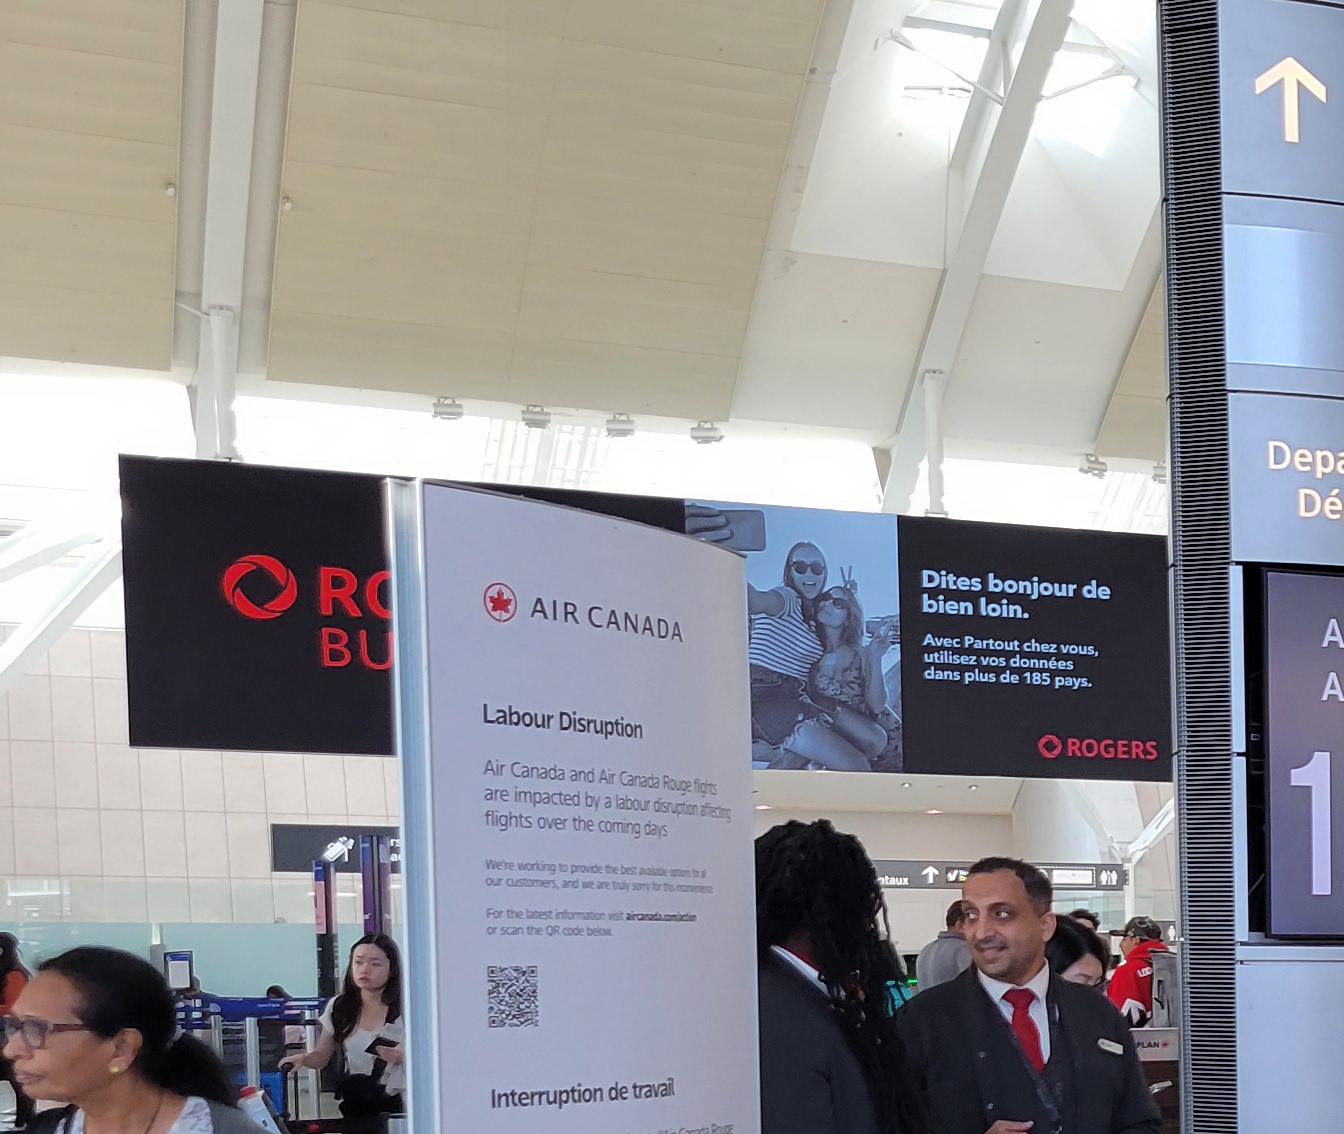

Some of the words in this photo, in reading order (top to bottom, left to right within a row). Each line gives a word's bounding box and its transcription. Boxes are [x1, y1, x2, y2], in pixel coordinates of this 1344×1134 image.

[921, 570, 982, 591] Dites
[986, 572, 1077, 600] bonjour
[1082, 579, 1111, 600] de
[921, 593, 974, 615] bien
[979, 597, 1030, 619] loin.
[530, 597, 580, 625] AIR
[588, 606, 683, 642] CANADA
[922, 634, 962, 648] Avec
[964, 635, 1020, 651] Partout
[1022, 638, 1058, 654] chez
[1060, 643, 1099, 658] vous,
[923, 650, 978, 666] utilisez
[980, 655, 1007, 667] vos
[1009, 654, 1074, 670] données
[924, 666, 961, 680] dans
[964, 668, 996, 685] plus
[999, 670, 1020, 684] de
[1023, 672, 1051, 685] 185
[1054, 675, 1093, 689] pays.
[483, 703, 554, 729] Labour
[559, 711, 643, 740] Disruption
[1067, 738, 1158, 759] ROGERS
[484, 759, 506, 776] Air
[511, 761, 565, 780] Canada
[570, 767, 595, 783] and
[598, 769, 616, 784] Air
[620, 771, 660, 789] Canada
[663, 775, 692, 796] Rouge
[484, 788, 509, 802] are
[514, 786, 580, 808] impacted
[585, 791, 600, 812] by
[604, 797, 612, 809] a
[615, 794, 651, 811] labour
[654, 798, 699, 818] disruption
[484, 810, 532, 831] flights
[538, 817, 568, 830] over
[572, 815, 595, 831] the
[598, 818, 641, 839] coming
[644, 820, 668, 839] days
[485, 859, 515, 870] We're
[518, 861, 556, 875] working
[559, 862, 568, 872] to
[571, 863, 603, 875] provide
[485, 877, 503, 887] our
[506, 878, 559, 890] customers,
[562, 878, 579, 889] and
[582, 881, 595, 889] we
[597, 881, 610, 890] are
[486, 907, 504, 919] For
[506, 909, 524, 919] the
[526, 908, 553, 920] latest
[555, 909, 606, 920] information
[486, 926, 497, 936] or
[500, 926, 524, 935] scan
[526, 924, 543, 935] the
[545, 925, 560, 937] QR
[563, 926, 584, 936] code
[491, 1082, 604, 1110] Interruption
[608, 1080, 629, 1101] de
[632, 1077, 675, 1100] travail
